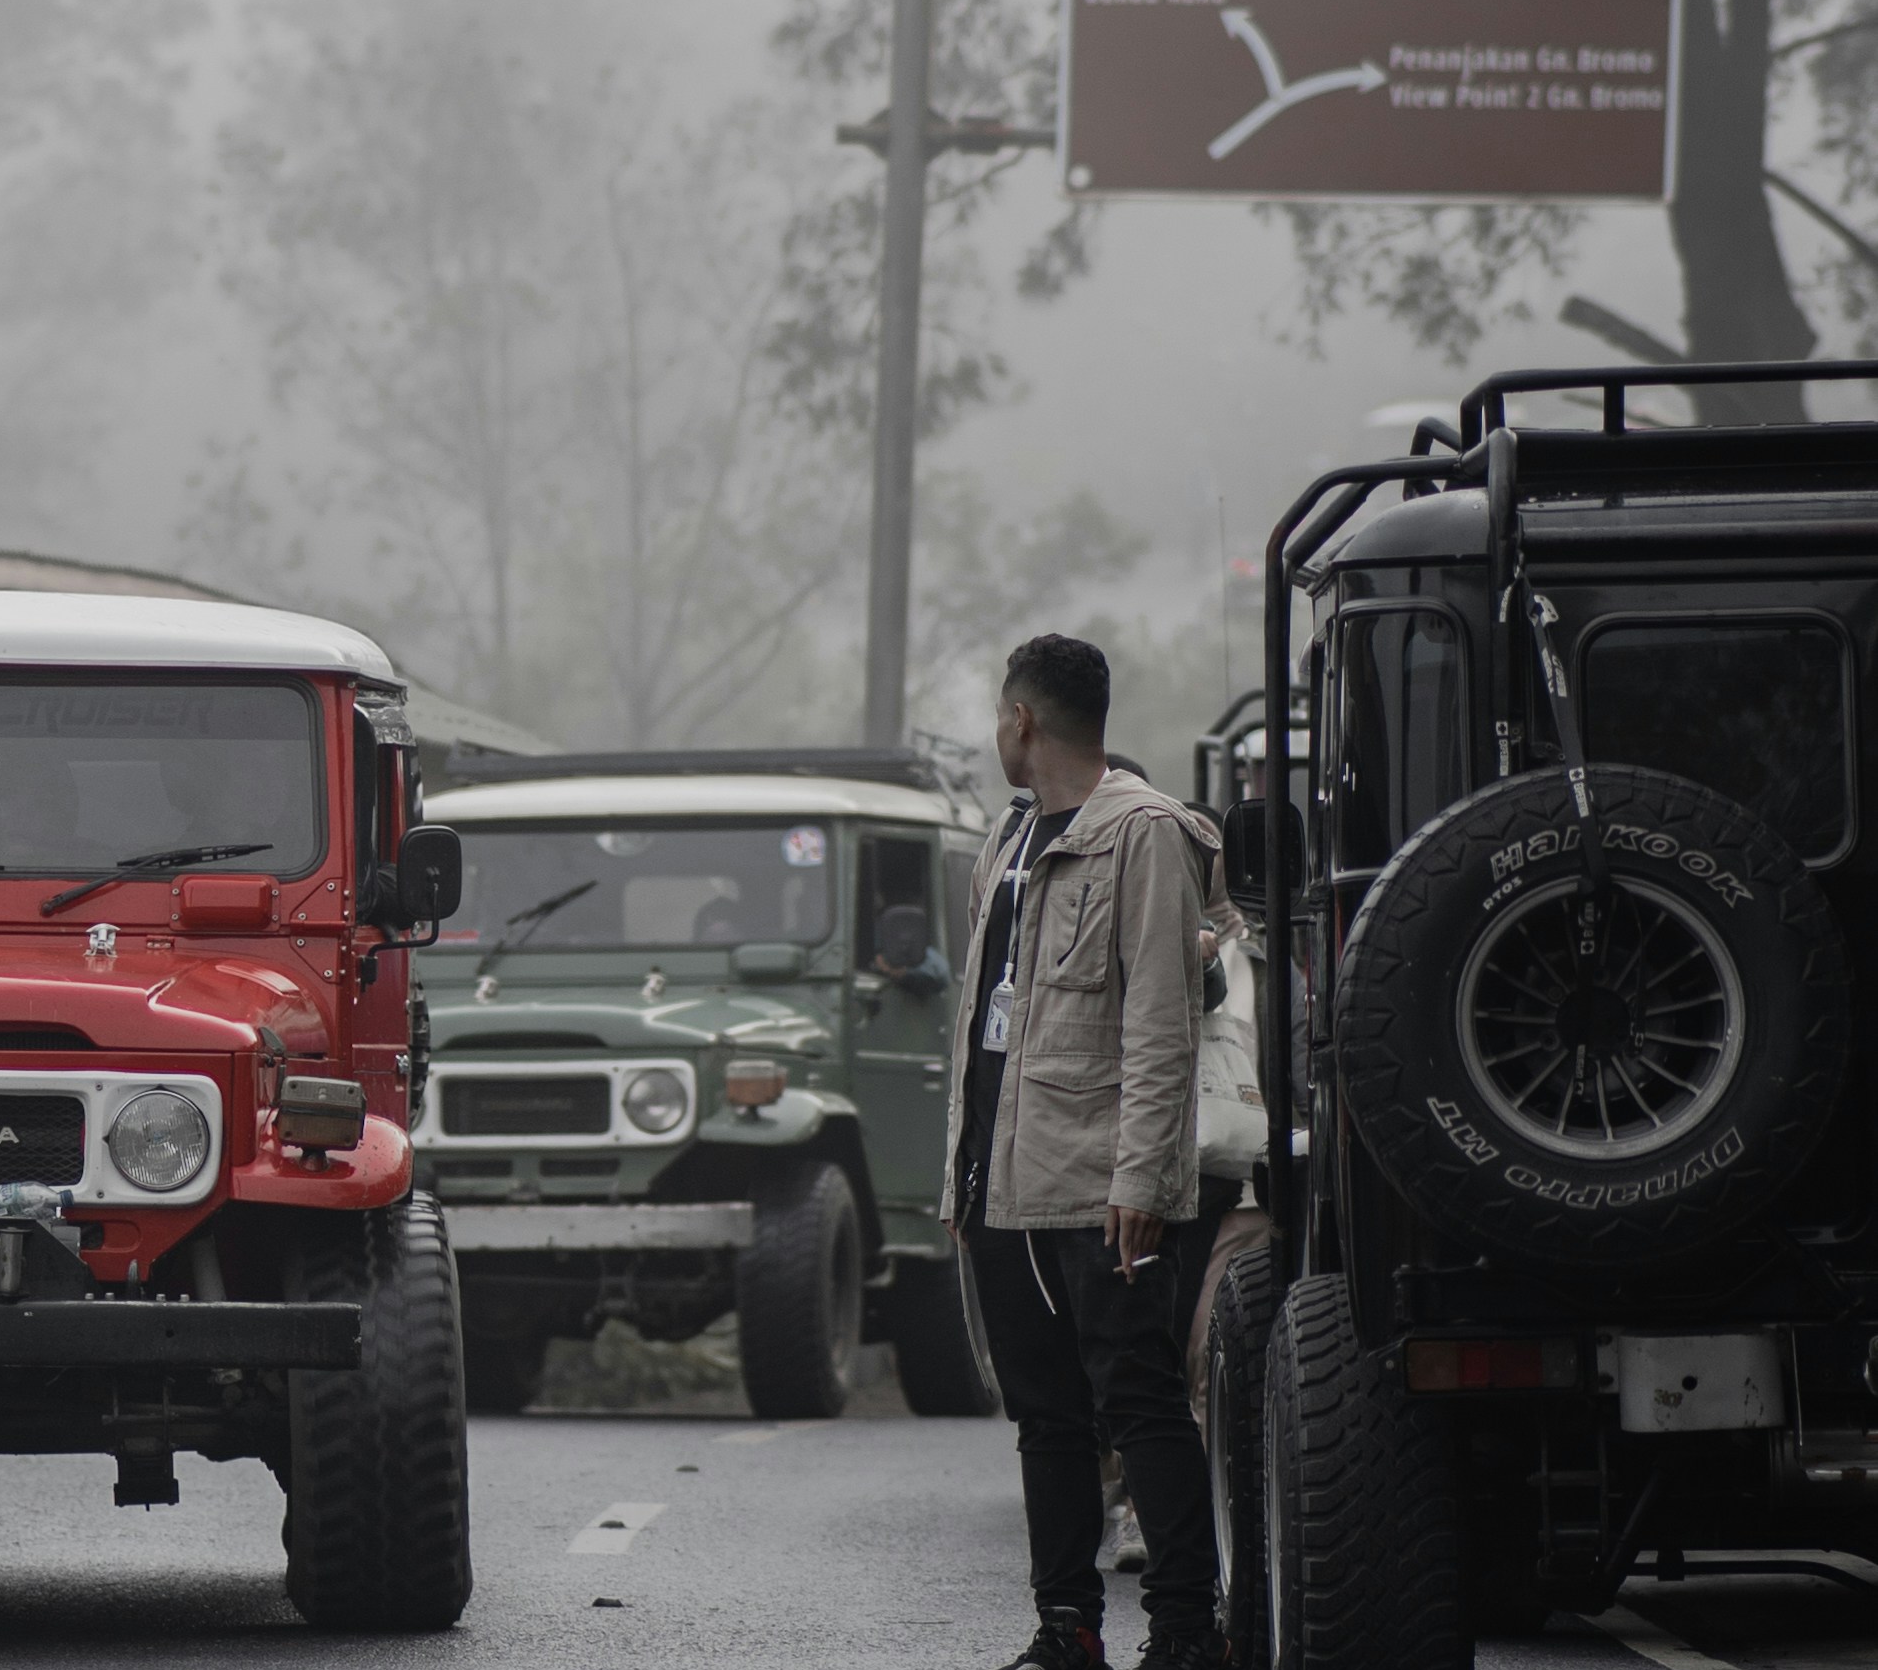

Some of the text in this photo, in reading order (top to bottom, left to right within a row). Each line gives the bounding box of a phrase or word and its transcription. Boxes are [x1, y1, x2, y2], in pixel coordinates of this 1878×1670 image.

[1389, 44, 1529, 82] Penanjakan
[1577, 45, 1654, 73] Bromo
[1389, 82, 1449, 109] View
[1455, 82, 1518, 109] Point
[1525, 84, 1541, 109] 2
[1589, 84, 1663, 110] Bromo
[1425, 1097, 1500, 1166] MT
